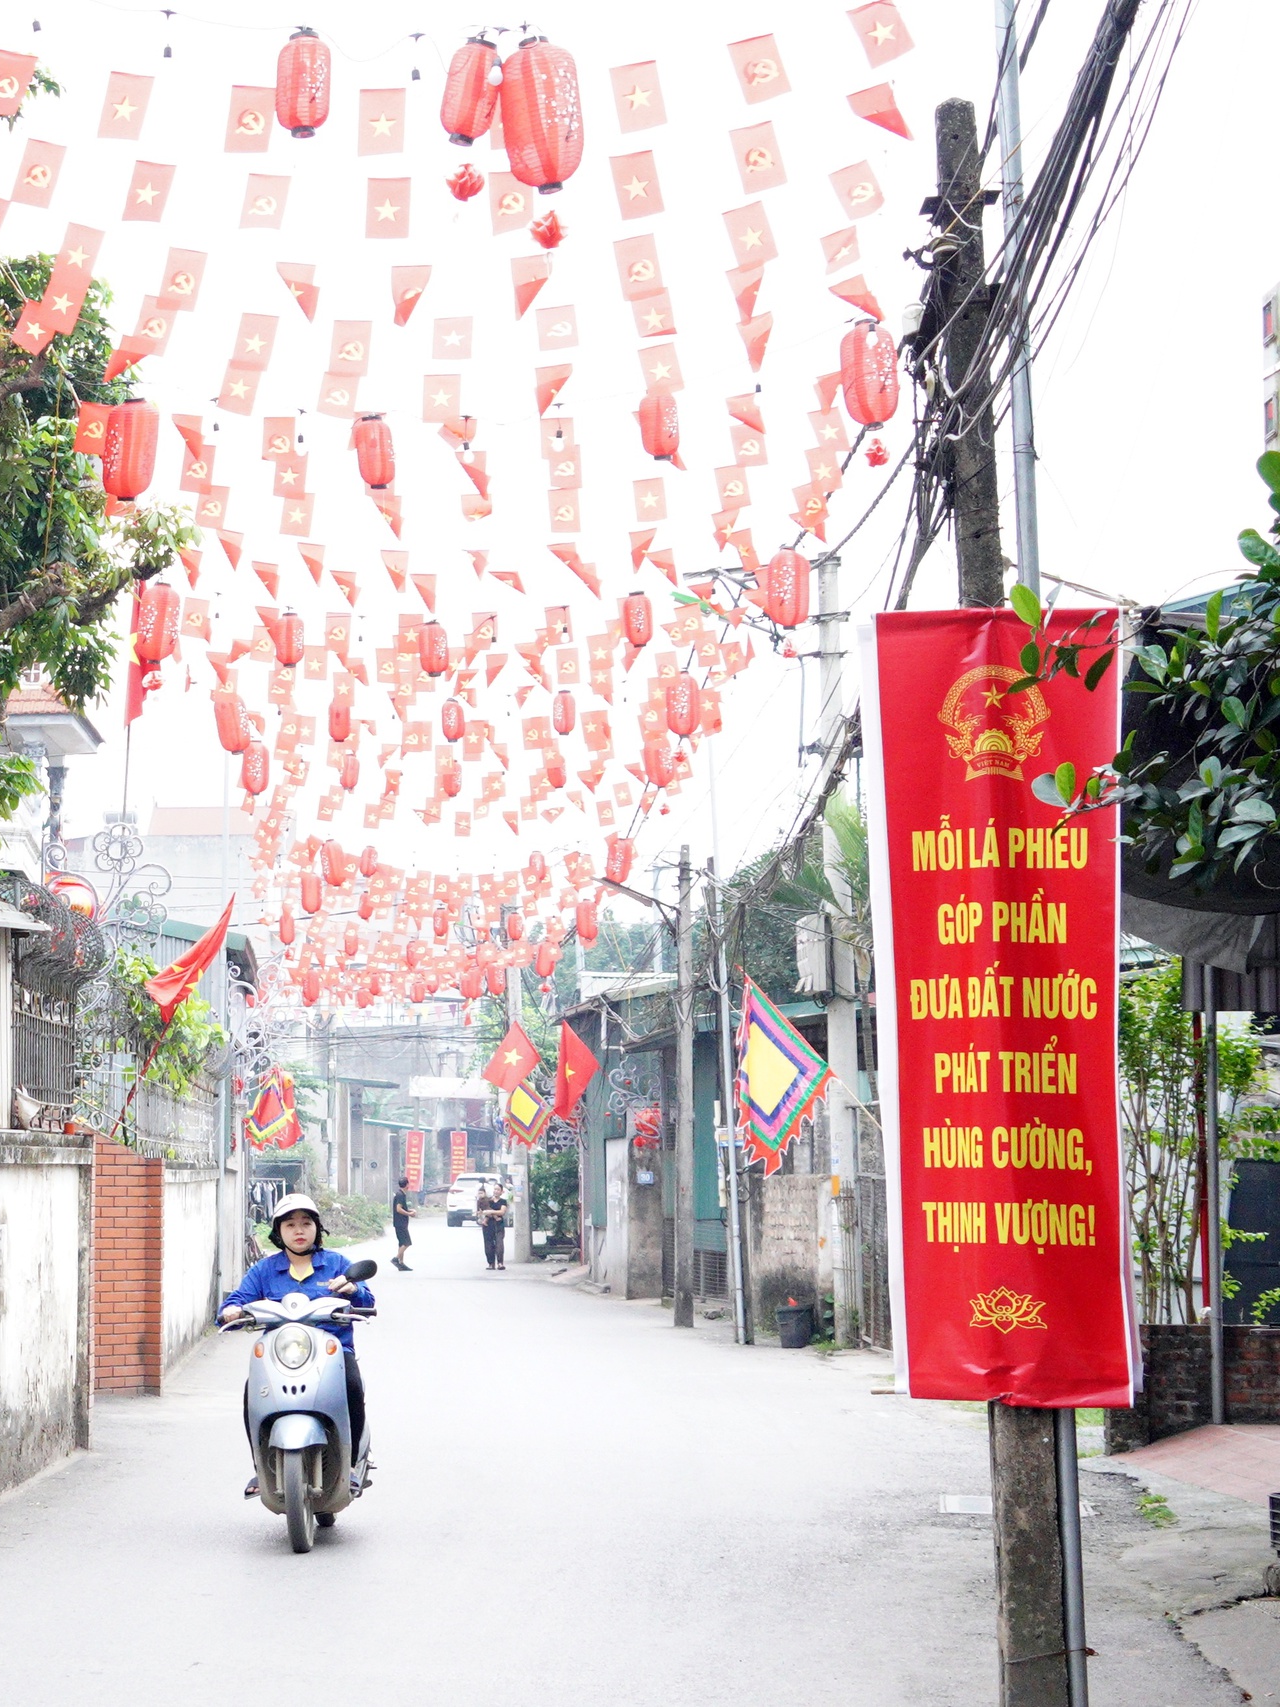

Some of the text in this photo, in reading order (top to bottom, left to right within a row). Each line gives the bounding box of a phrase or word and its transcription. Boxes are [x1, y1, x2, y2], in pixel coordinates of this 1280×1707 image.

[912, 814, 1088, 872] MỖI LÁ PHIẾU
[937, 887, 1067, 945] GÓP PHẦN
[910, 961, 1098, 1020] ĐƯA ĐẤT NƯỚC
[934, 1035, 1077, 1095] PHÁT TRIỂN
[923, 1116, 1093, 1176] HÙNG CƯỜNG,
[922, 1198, 1096, 1255] THỊNH VƯỢNG!
